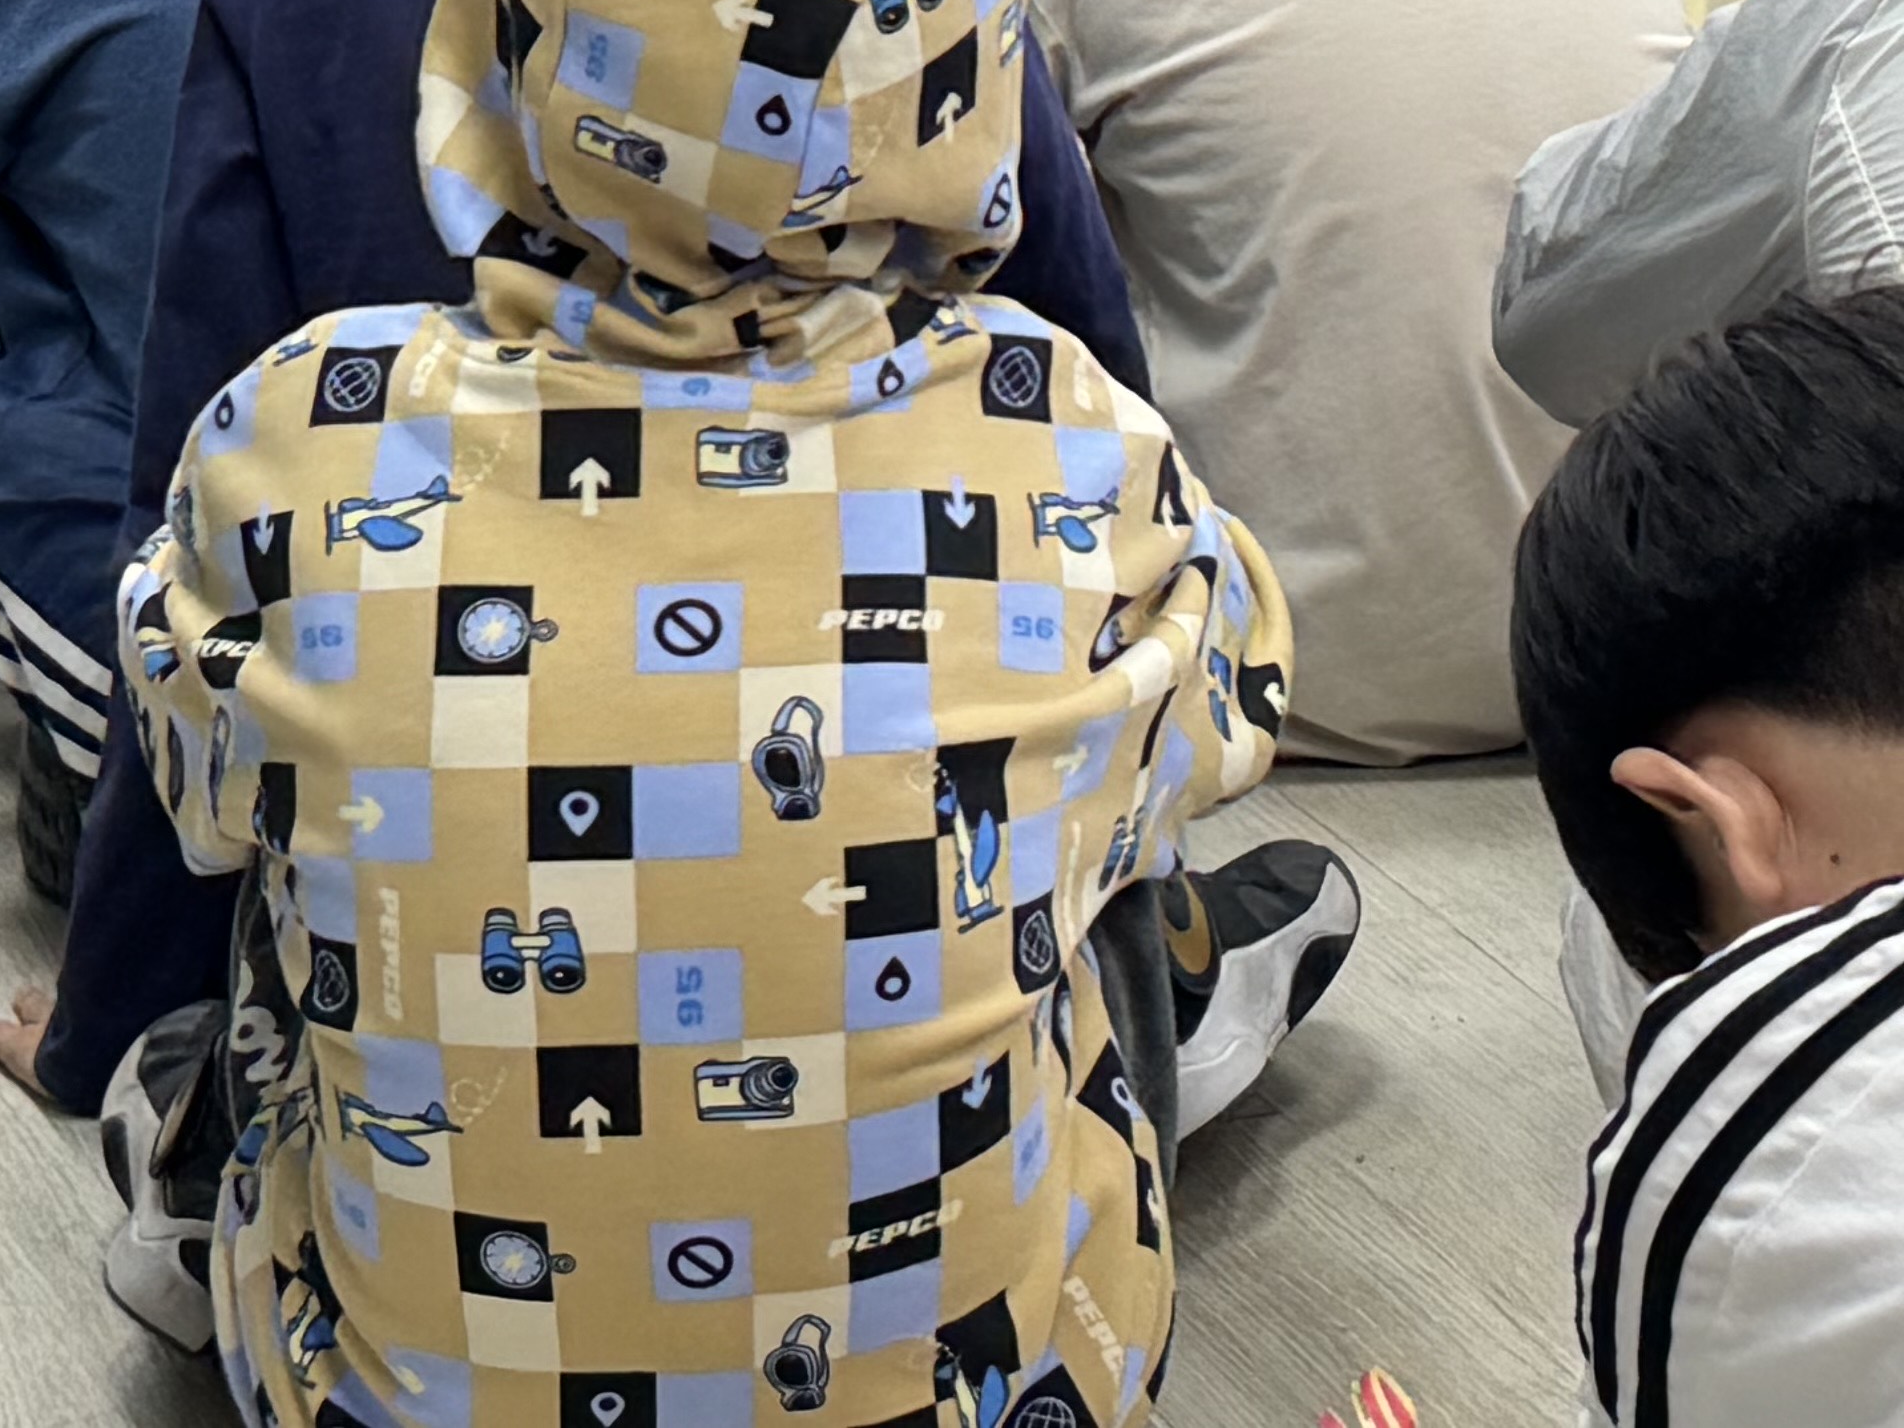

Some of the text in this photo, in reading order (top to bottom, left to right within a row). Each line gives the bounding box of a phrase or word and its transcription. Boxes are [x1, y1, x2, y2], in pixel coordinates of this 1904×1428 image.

[817, 608, 945, 632] PEPCO
[379, 887, 404, 1021] PEPCO
[828, 1199, 964, 1258] PEPCO
